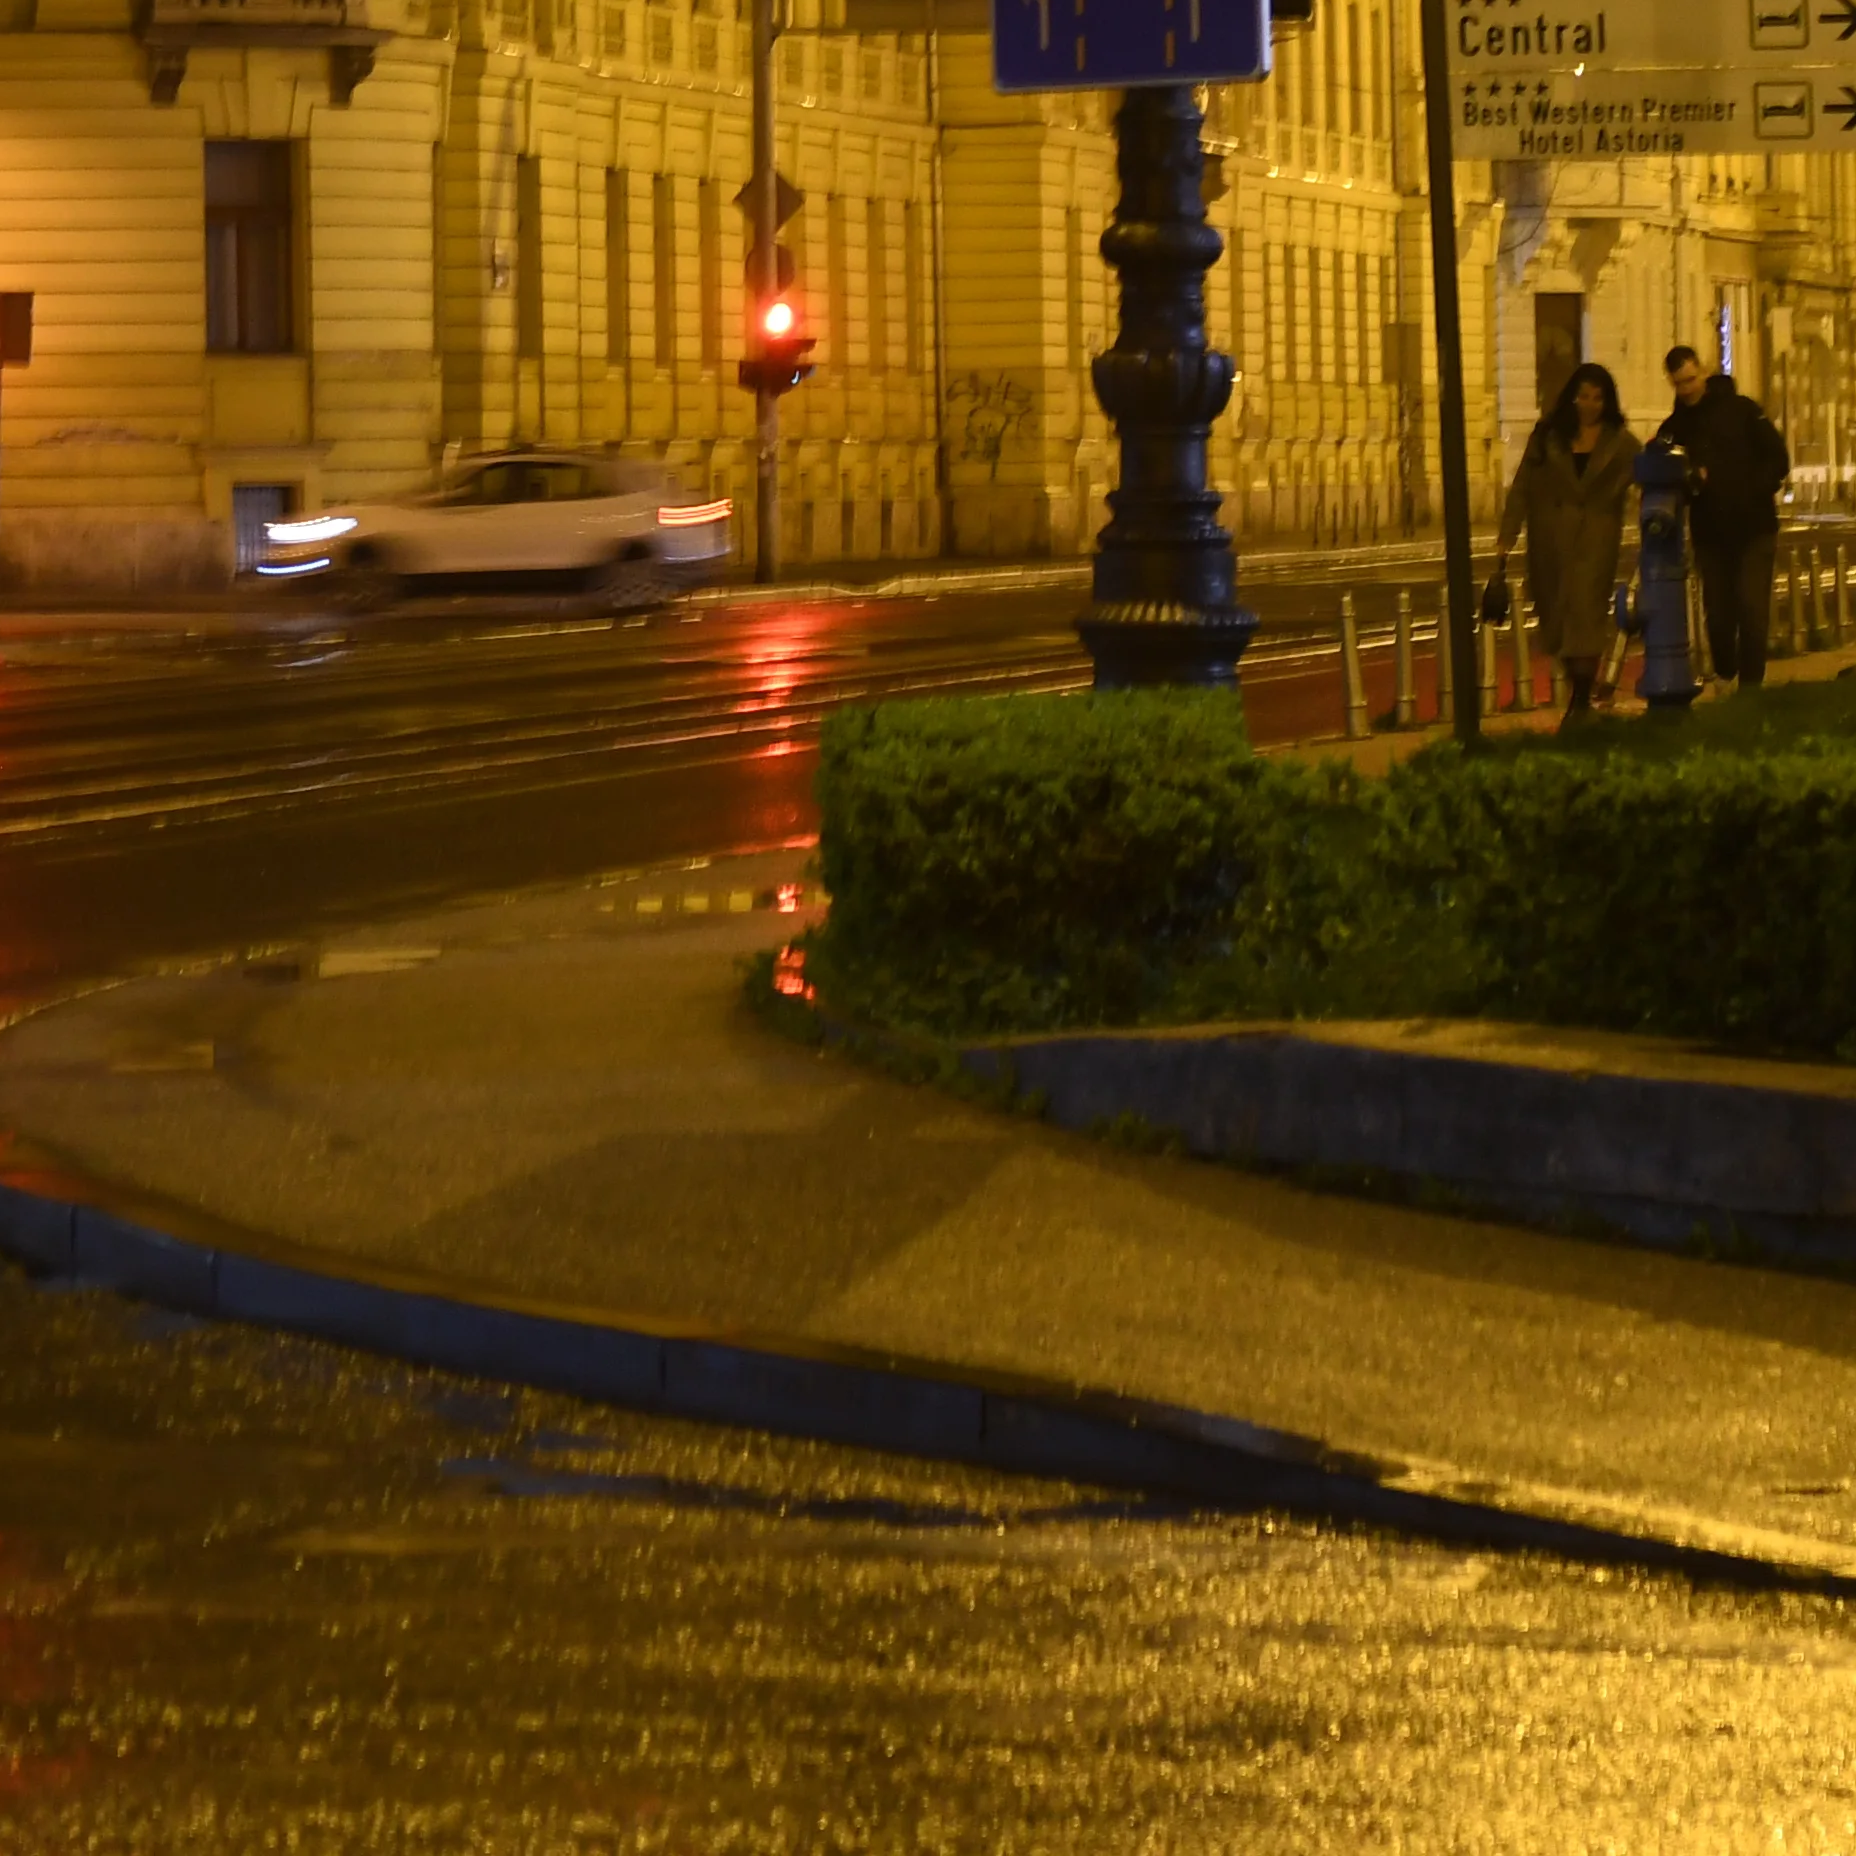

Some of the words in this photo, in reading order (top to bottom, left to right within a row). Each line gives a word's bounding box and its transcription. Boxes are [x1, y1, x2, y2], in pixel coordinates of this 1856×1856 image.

[1457, 11, 1607, 57] Central
[1462, 100, 1520, 127] Best
[1528, 97, 1636, 126] Western
[1641, 96, 1737, 123] Premier
[1518, 126, 1585, 155] Hotel
[1596, 125, 1685, 153] Astoria
